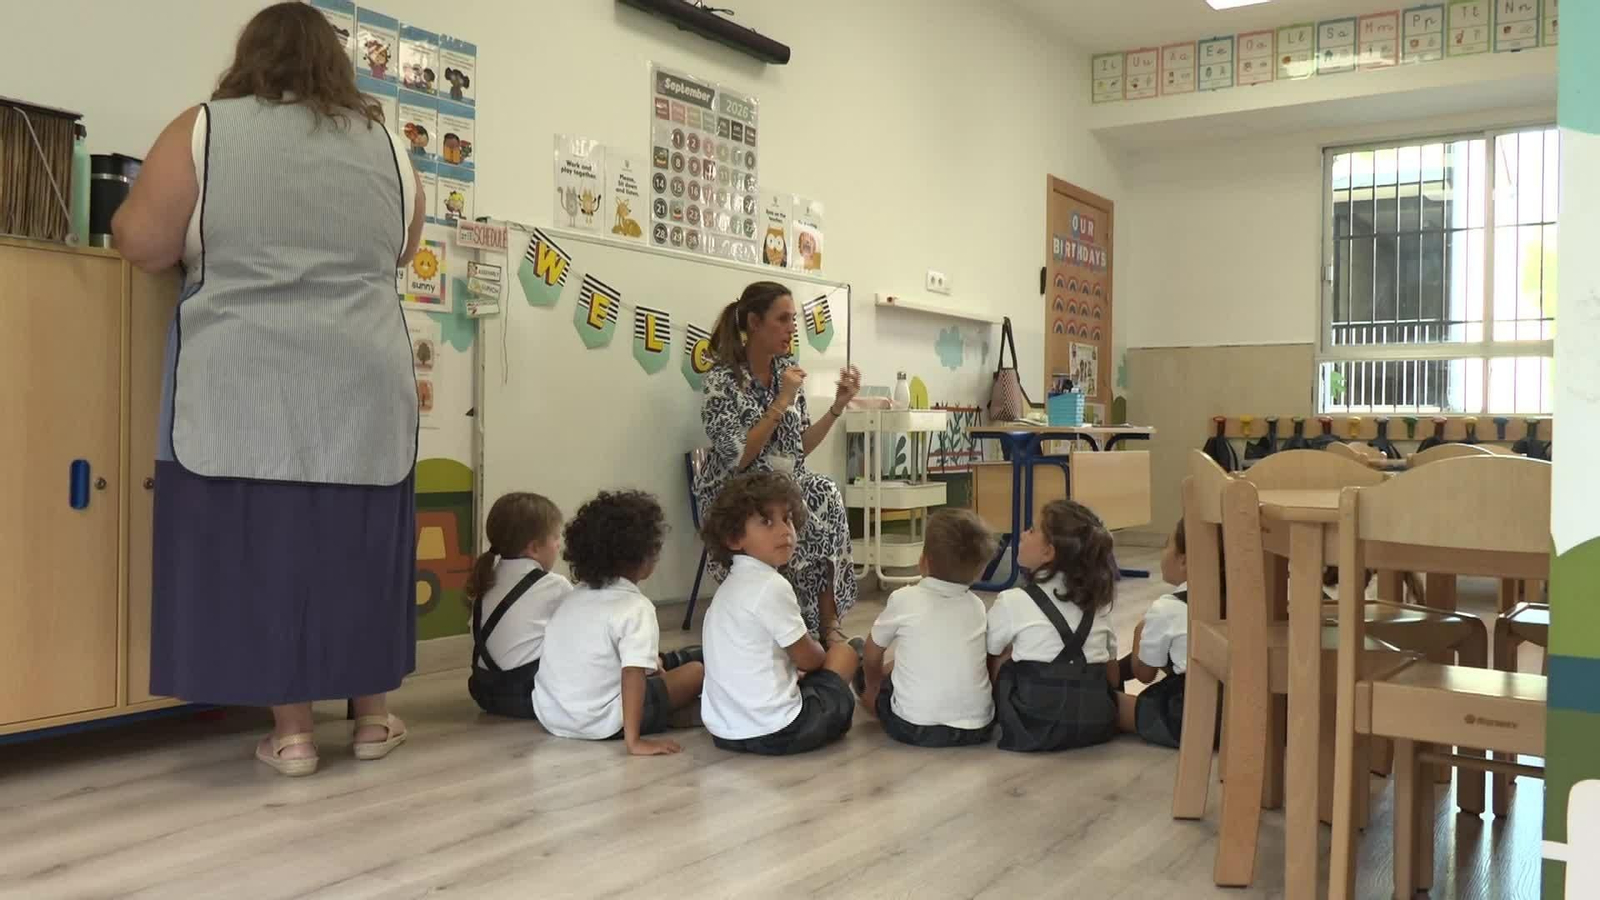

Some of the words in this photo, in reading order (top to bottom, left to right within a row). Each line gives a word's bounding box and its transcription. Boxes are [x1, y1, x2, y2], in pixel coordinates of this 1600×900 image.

[664, 78, 711, 103] September
[726, 99, 749, 119] 2026
[655, 179, 664, 189] 14
[657, 204, 665, 213] 21
[656, 229, 666, 239] 28
[1072, 214, 1094, 237] OUR
[473, 225, 508, 249] SCHEDULE
[1053, 237, 1107, 267] BIRTHDAYS
[411, 282, 436, 293] sunny
